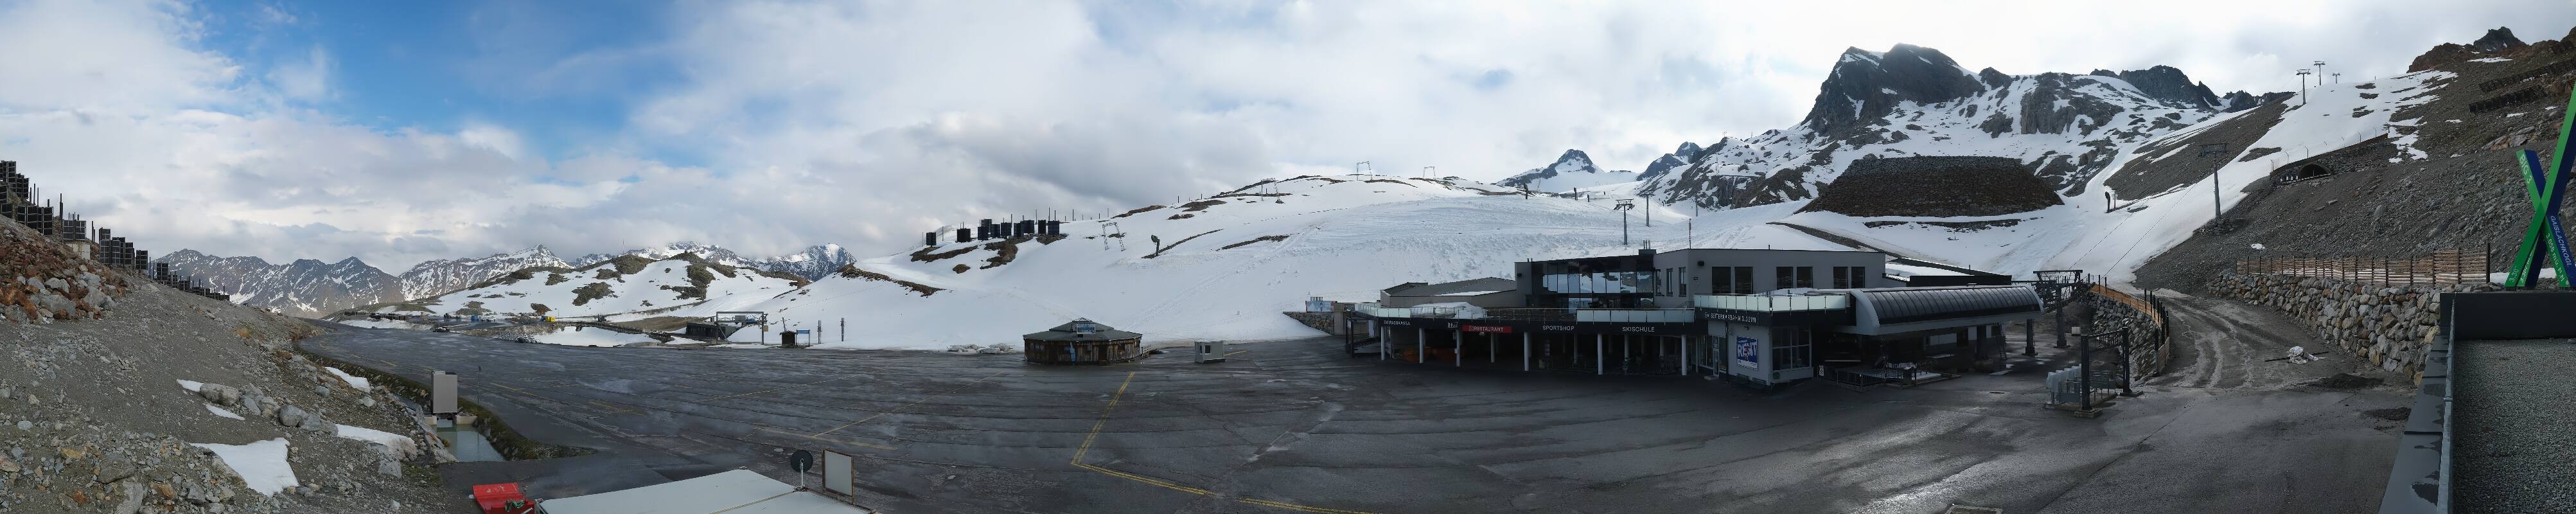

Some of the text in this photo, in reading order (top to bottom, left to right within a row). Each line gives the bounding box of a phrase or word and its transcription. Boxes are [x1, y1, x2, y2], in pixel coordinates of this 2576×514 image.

[2519, 154, 2532, 184] BIG 3
[2550, 216, 2572, 267] GAISLACHKOGL
